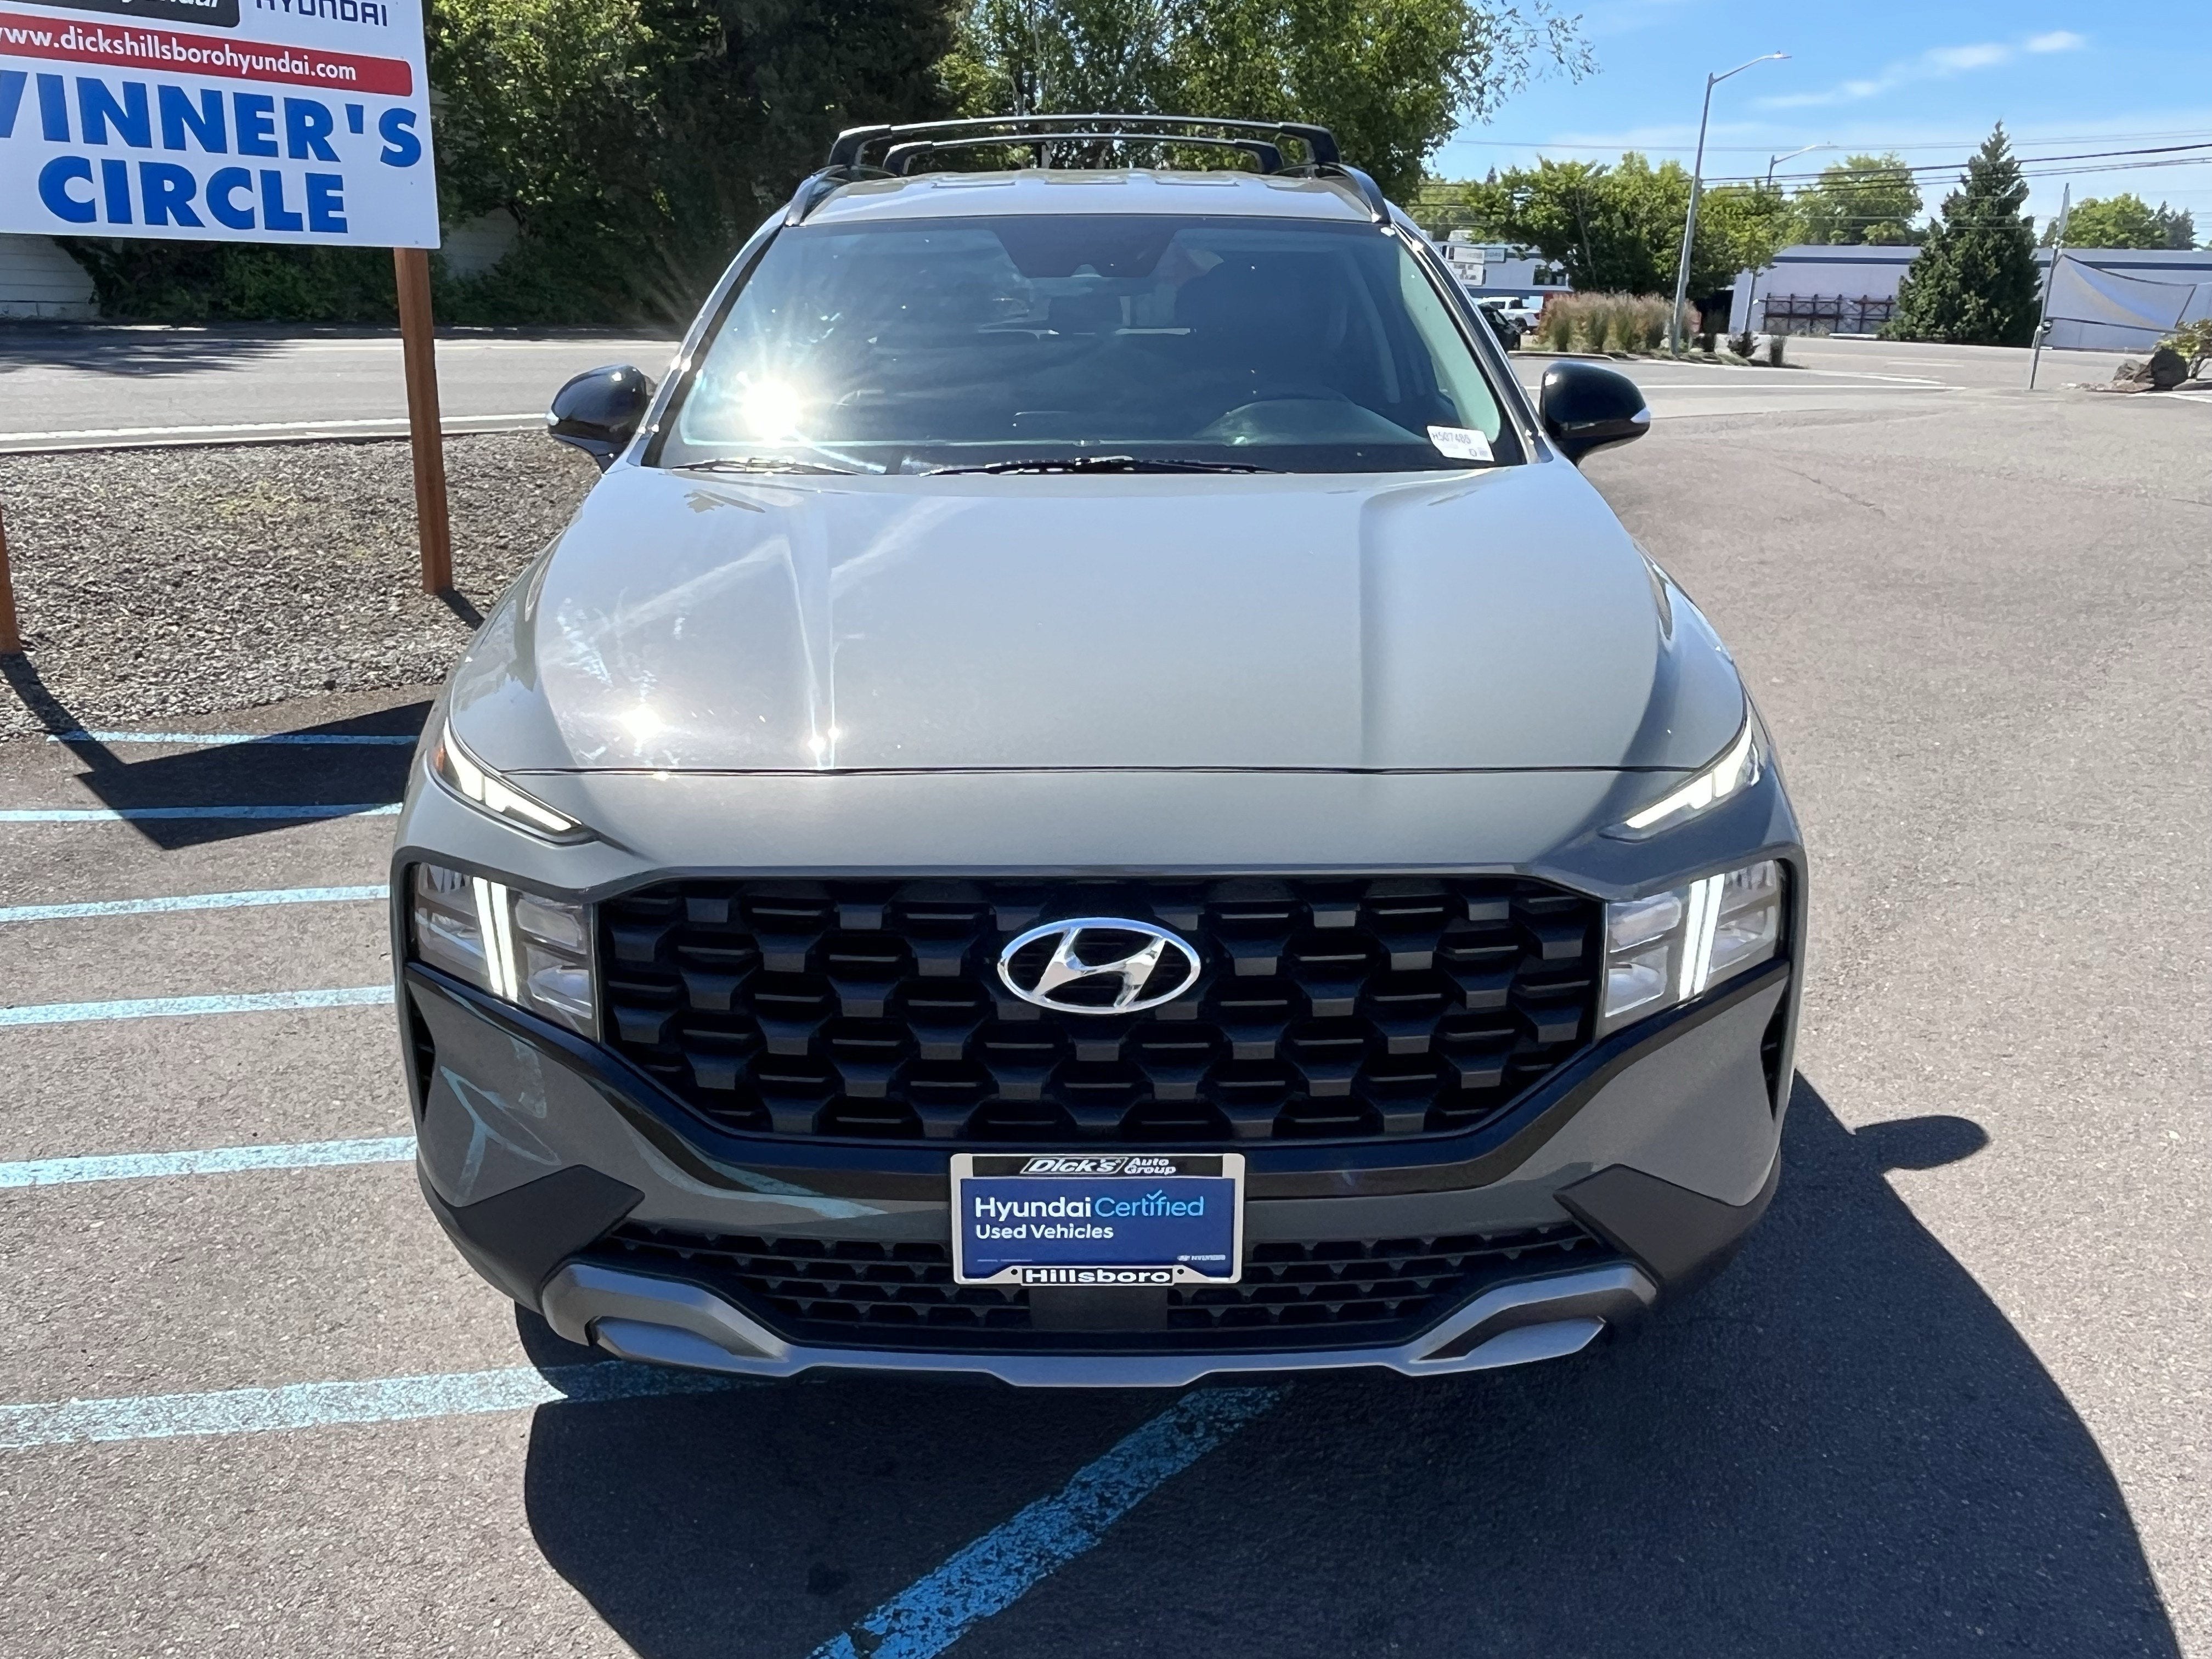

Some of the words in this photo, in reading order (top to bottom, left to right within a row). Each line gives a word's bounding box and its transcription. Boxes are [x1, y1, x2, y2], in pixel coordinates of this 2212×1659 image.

[0, 26, 356, 81] ww.dickshillsborohyundai.com
[38, 156, 348, 234] CIRCLE
[1124, 1165, 1176, 1175] Group
[1128, 1158, 1169, 1166] Auto
[975, 1197, 1091, 1221] Hyundai
[1094, 1193, 1204, 1217] Certified
[976, 1224, 1026, 1239] Used
[1030, 1223, 1114, 1239] Vehicles
[1025, 1269, 1171, 1283] Hillsboro
